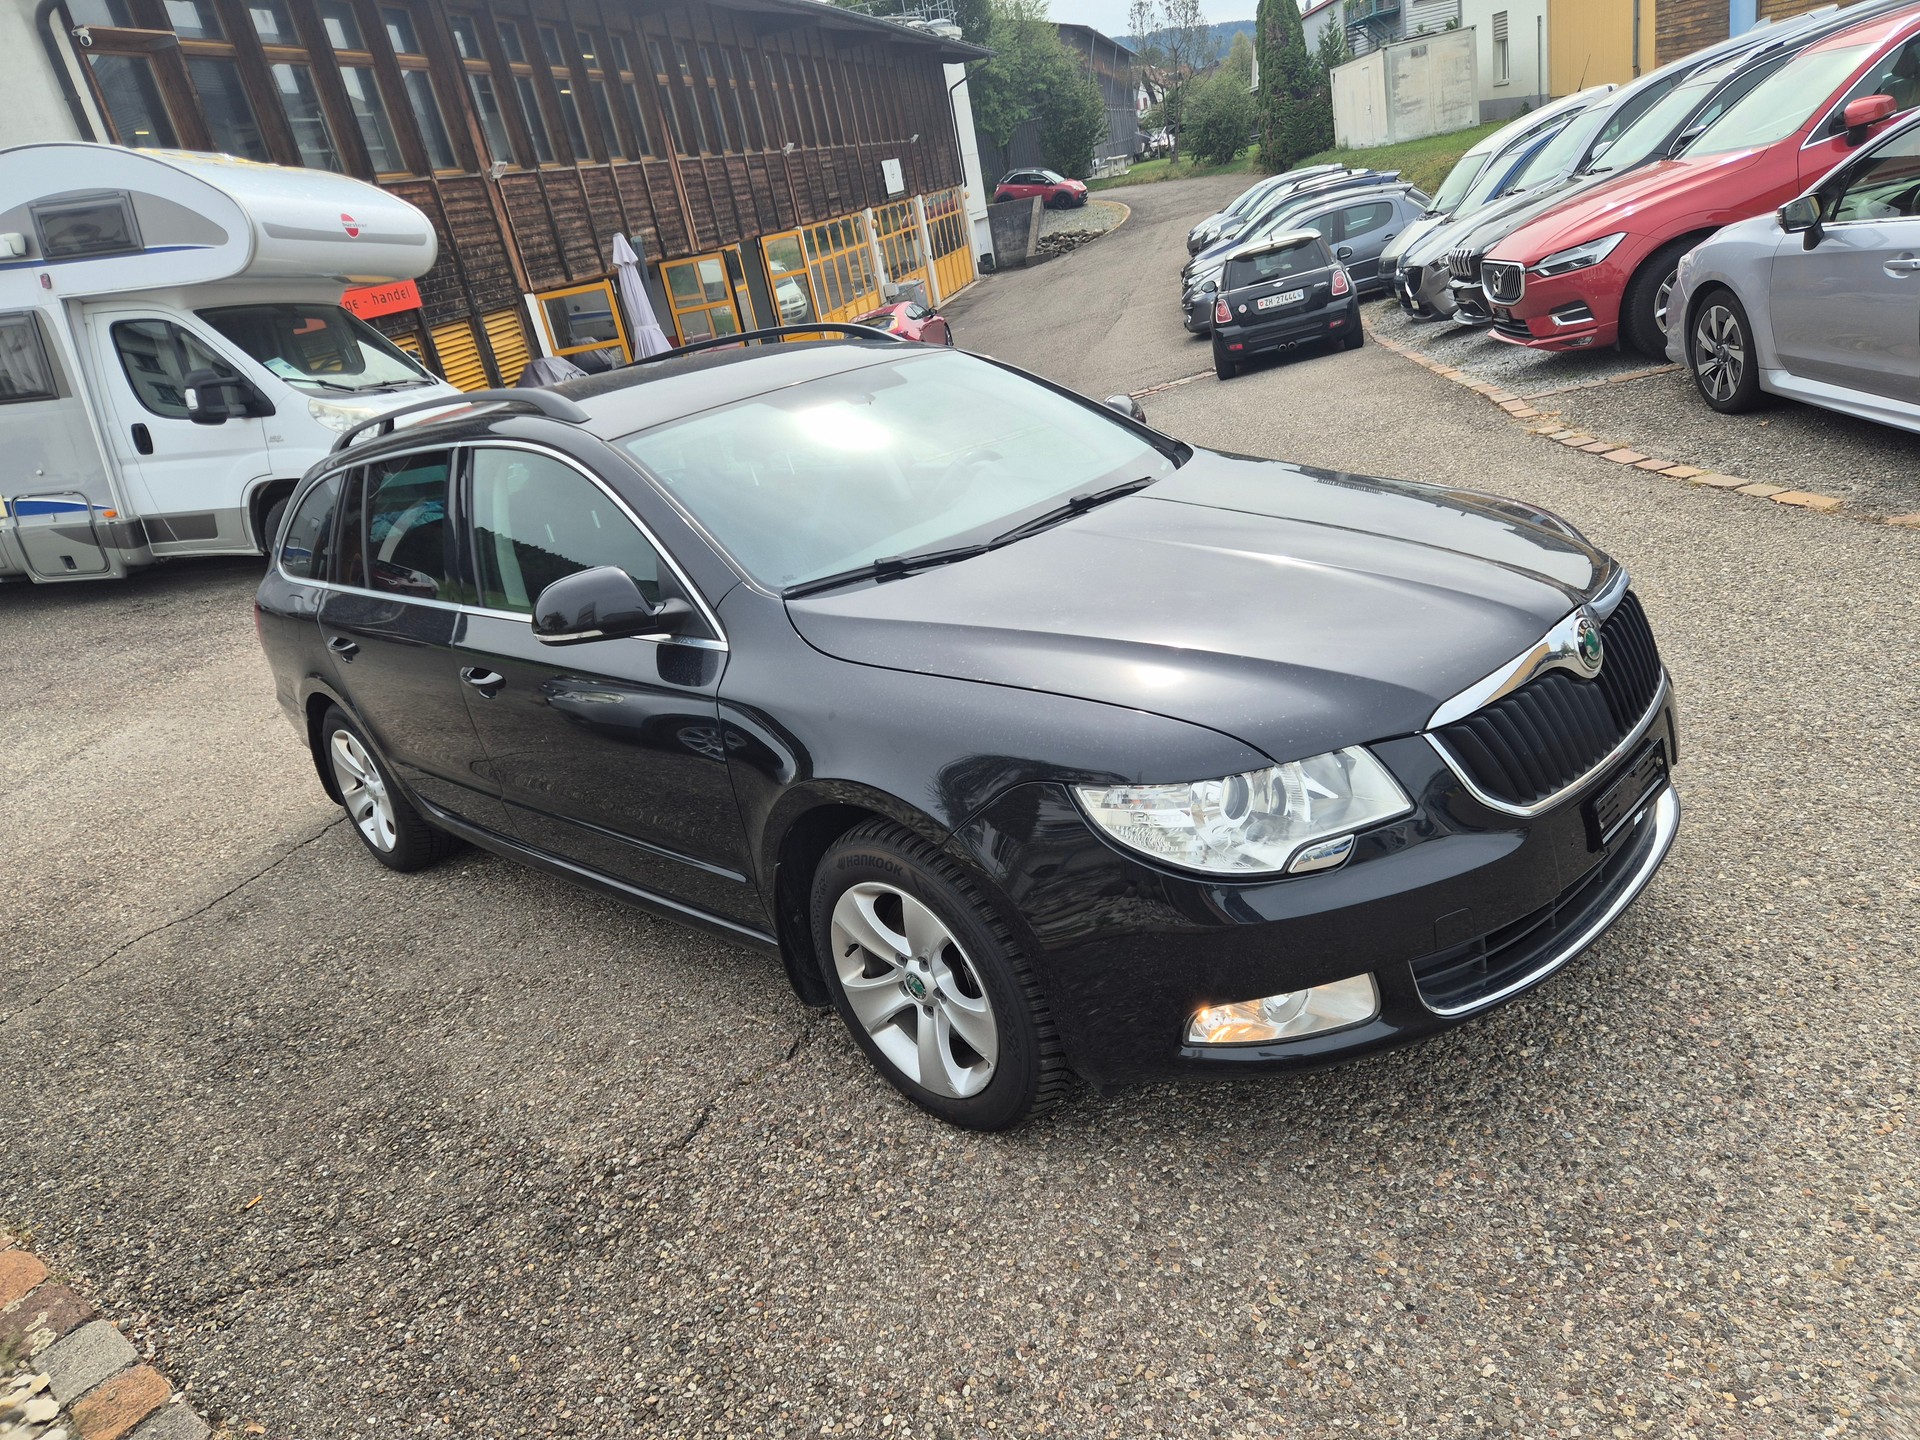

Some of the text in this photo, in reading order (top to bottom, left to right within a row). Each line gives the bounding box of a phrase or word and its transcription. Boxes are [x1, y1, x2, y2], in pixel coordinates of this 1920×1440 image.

[341, 299, 359, 312] ge
[371, 286, 411, 305] handel
[1264, 292, 1297, 307] ZH 27444
